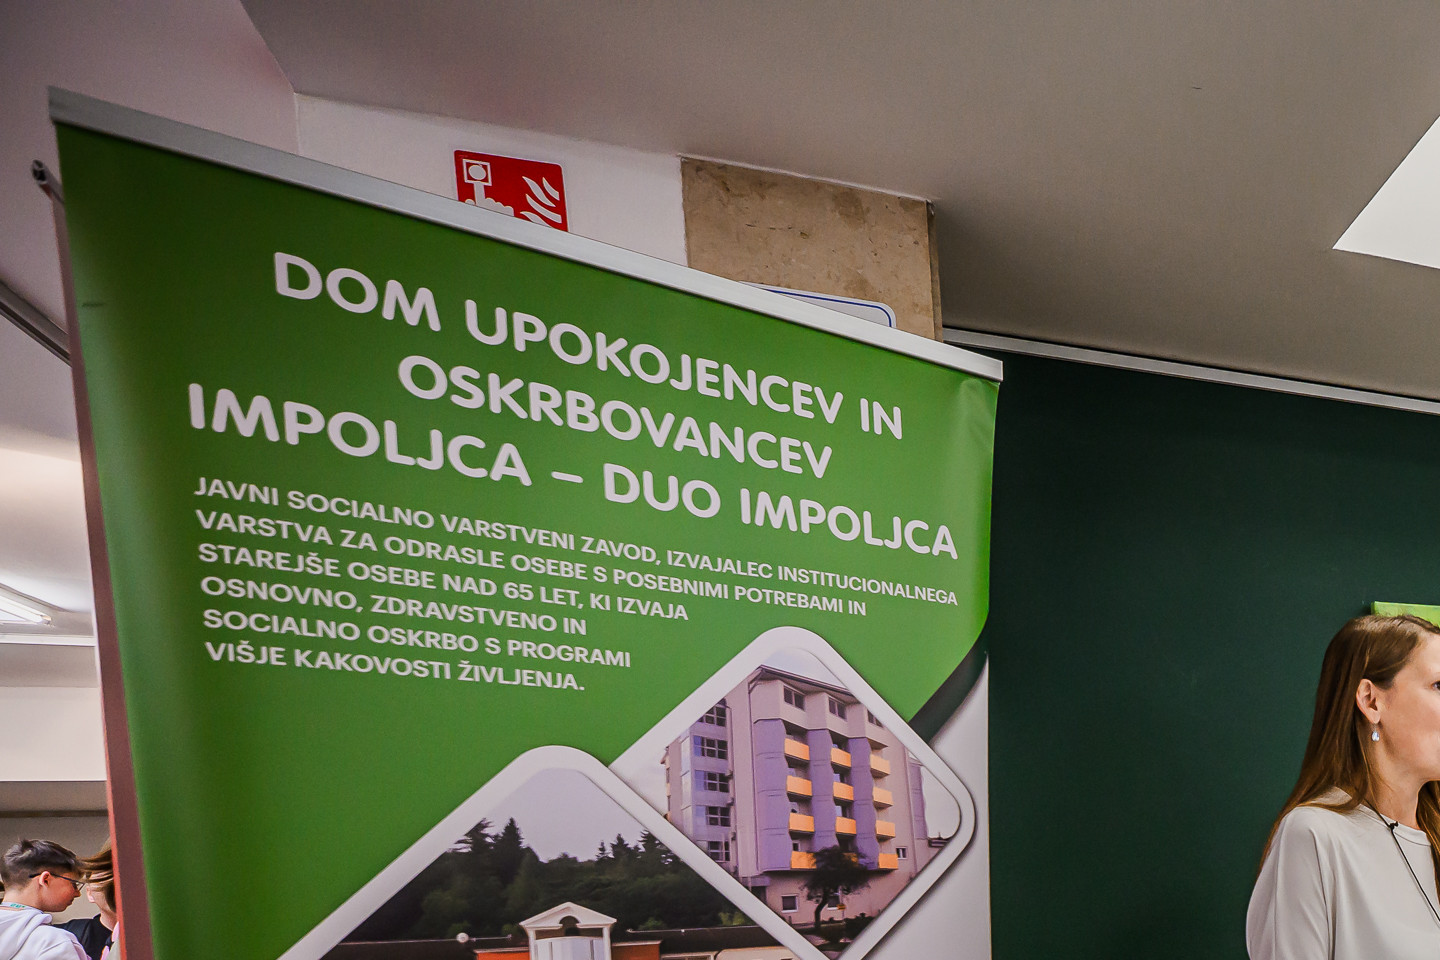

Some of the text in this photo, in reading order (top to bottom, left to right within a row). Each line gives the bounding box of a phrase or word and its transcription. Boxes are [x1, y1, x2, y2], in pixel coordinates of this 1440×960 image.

[275, 252, 902, 439] DOM UPOKOJENCEV IN
[399, 356, 832, 478] OSKRBOVANCEV
[189, 383, 958, 559] IMPOLJCA DUO IMPOLJCA
[194, 477, 958, 605] JAVNI SOCIALNO VARSTVENI ZAVOD, IZVAJALEC INSTITUCIONALNEGA
[196, 510, 866, 615] VARSTVA ZA ODRASLE OSEBE S POSEBNIMI POTREBAMI IN
[199, 543, 688, 620] STAREJŠE OSEBE NAD 65 LET, KI IZVAJA
[201, 577, 586, 635] OSNOVNO, ZDRAVSTVENO IN
[204, 609, 630, 667] SOCIALNO OSKRBO S PROGRAMI
[206, 640, 584, 690] VIŠJE KAKOVOSTI ŽIVLJENJA.
